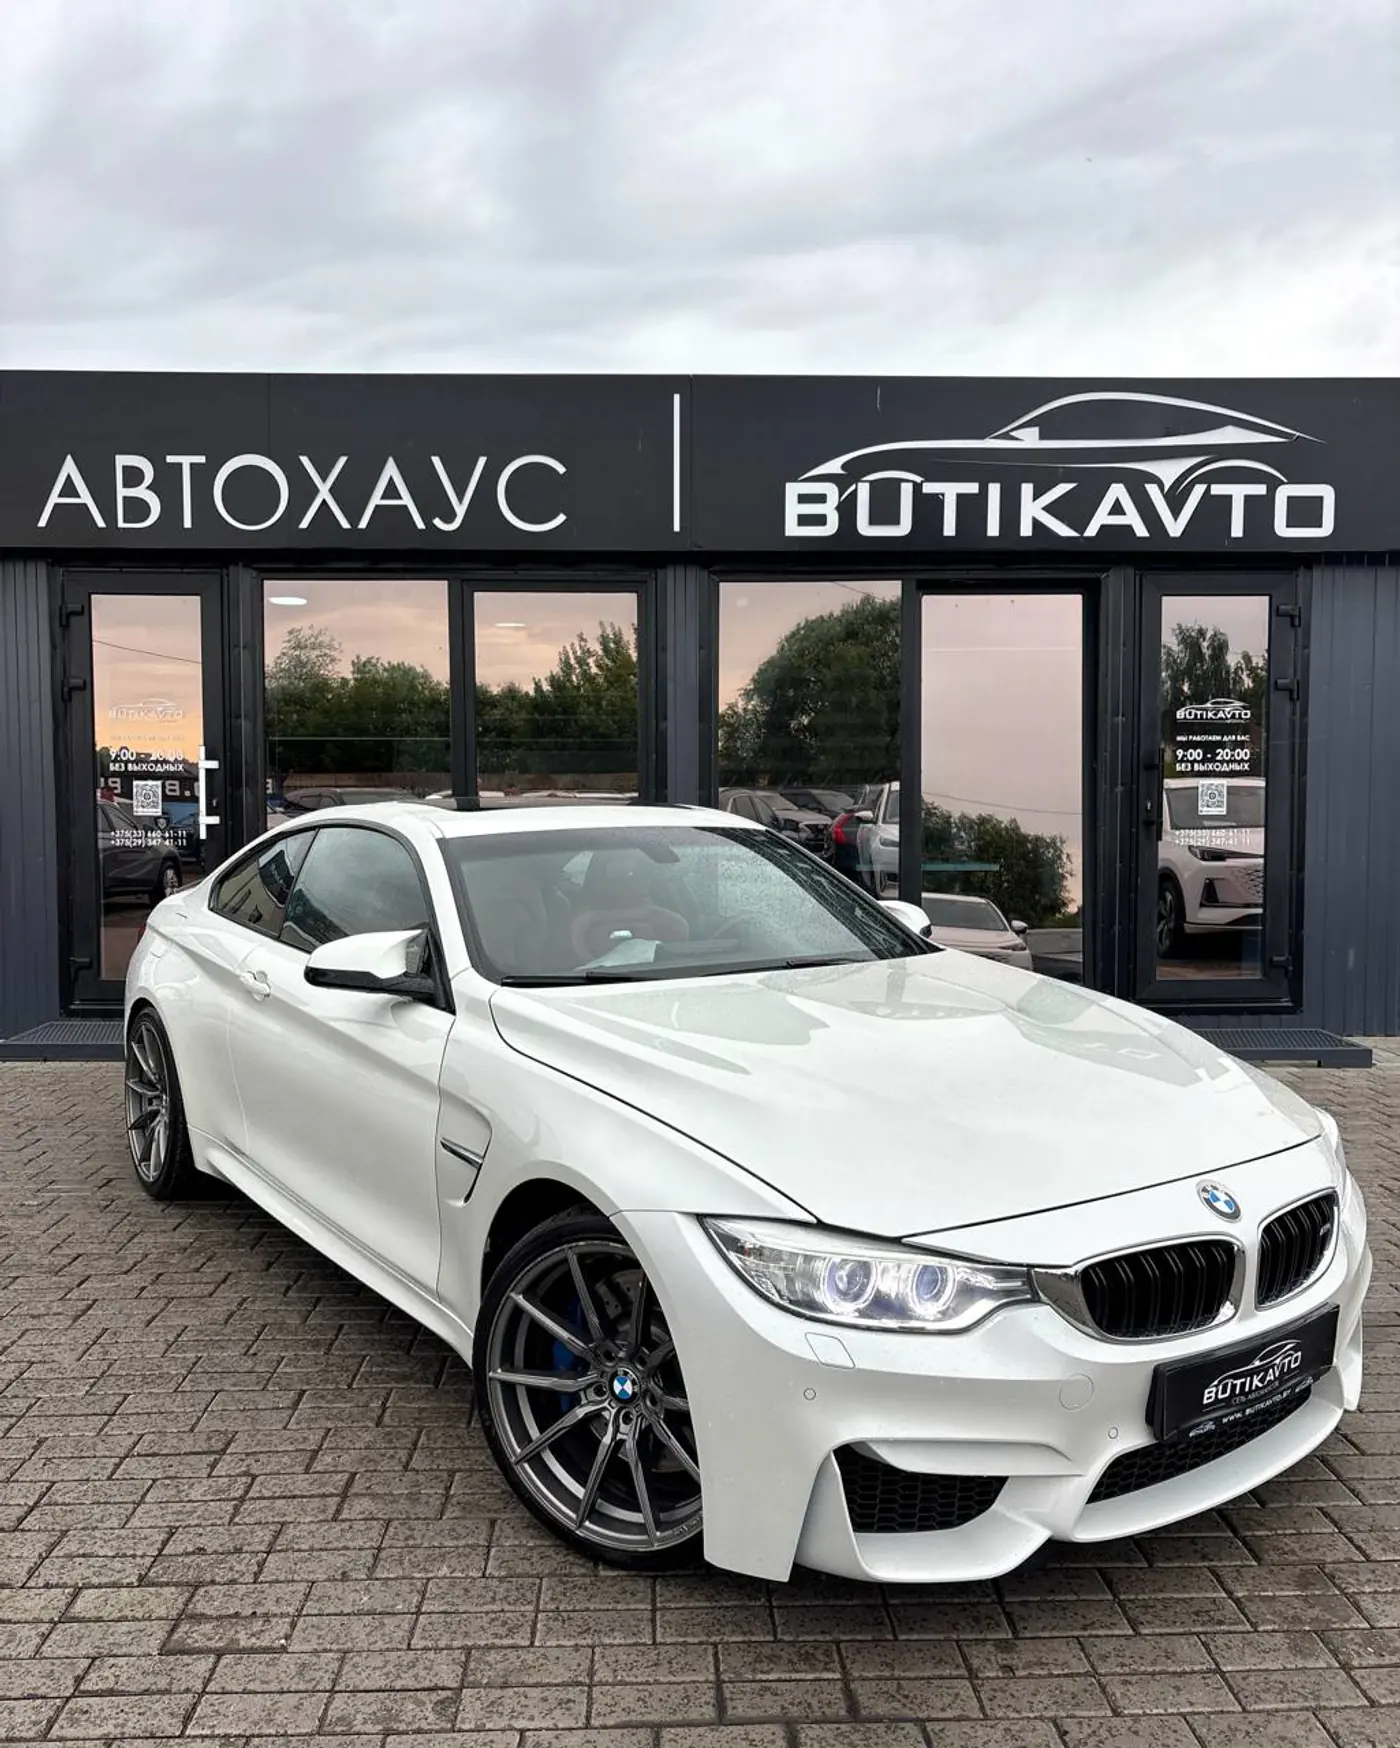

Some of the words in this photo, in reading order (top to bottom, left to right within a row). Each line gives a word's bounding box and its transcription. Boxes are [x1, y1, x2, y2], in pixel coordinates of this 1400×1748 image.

[37, 453, 568, 532] АВТОХАУС
[785, 480, 1335, 539] BUTIKAVTO
[1176, 709, 1251, 719] BUTIKAVTO
[109, 749, 136, 761] 9:00
[1176, 749, 1203, 760] 9:00
[1215, 749, 1250, 760] 20:00
[109, 763, 126, 772] БЕЗ
[127, 763, 185, 772] ВЫХОДНЫХ
[1176, 763, 1191, 771] БЕЗ
[1194, 763, 1250, 771] ВЫХОДНЫХ
[1203, 1351, 1302, 1405] BUTIKAVTO
